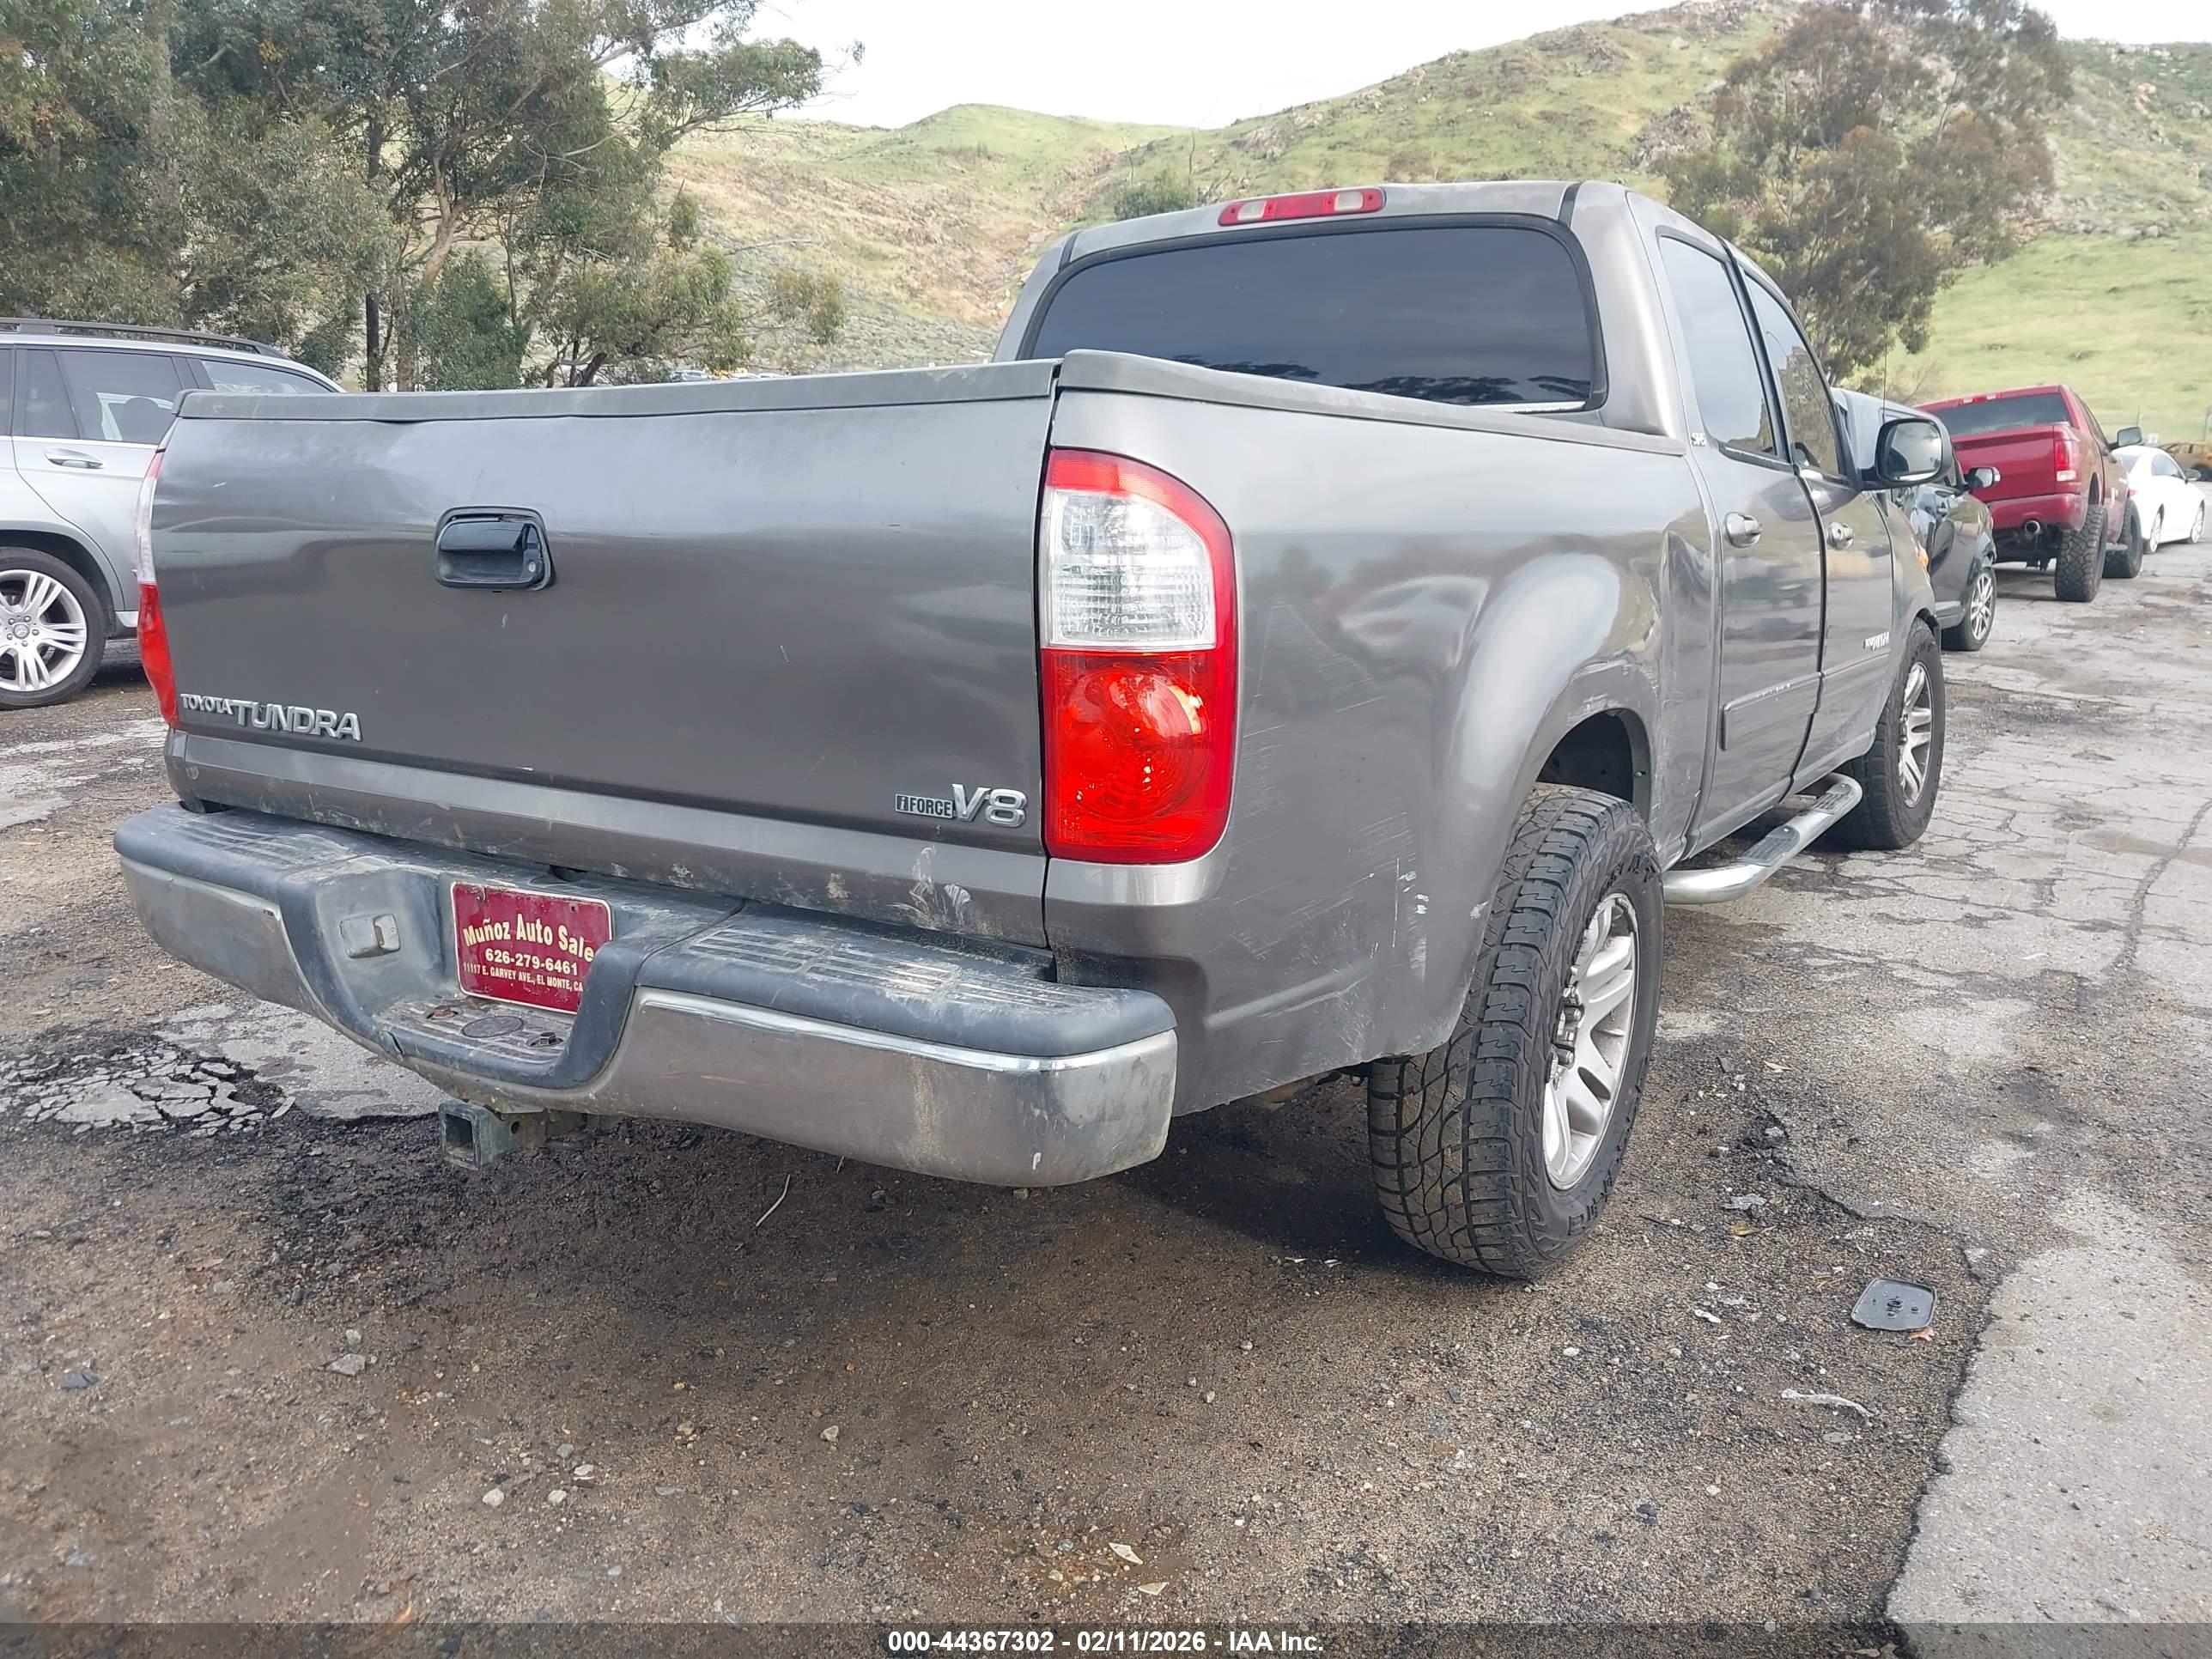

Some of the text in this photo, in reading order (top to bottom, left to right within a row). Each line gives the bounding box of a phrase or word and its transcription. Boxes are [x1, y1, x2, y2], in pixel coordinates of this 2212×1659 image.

[180, 693, 362, 742] TOYOTA TUNDRA
[951, 783, 1027, 828] V8
[463, 917, 511, 947] Muñoz
[516, 913, 554, 946] Auto
[485, 947, 578, 976] 626-279-6461
[482, 965, 489, 976] E.
[489, 966, 517, 981] GARVEY
[536, 974, 546, 986] EL
[546, 975, 573, 993] MONTE,
[573, 981, 584, 993] CA
